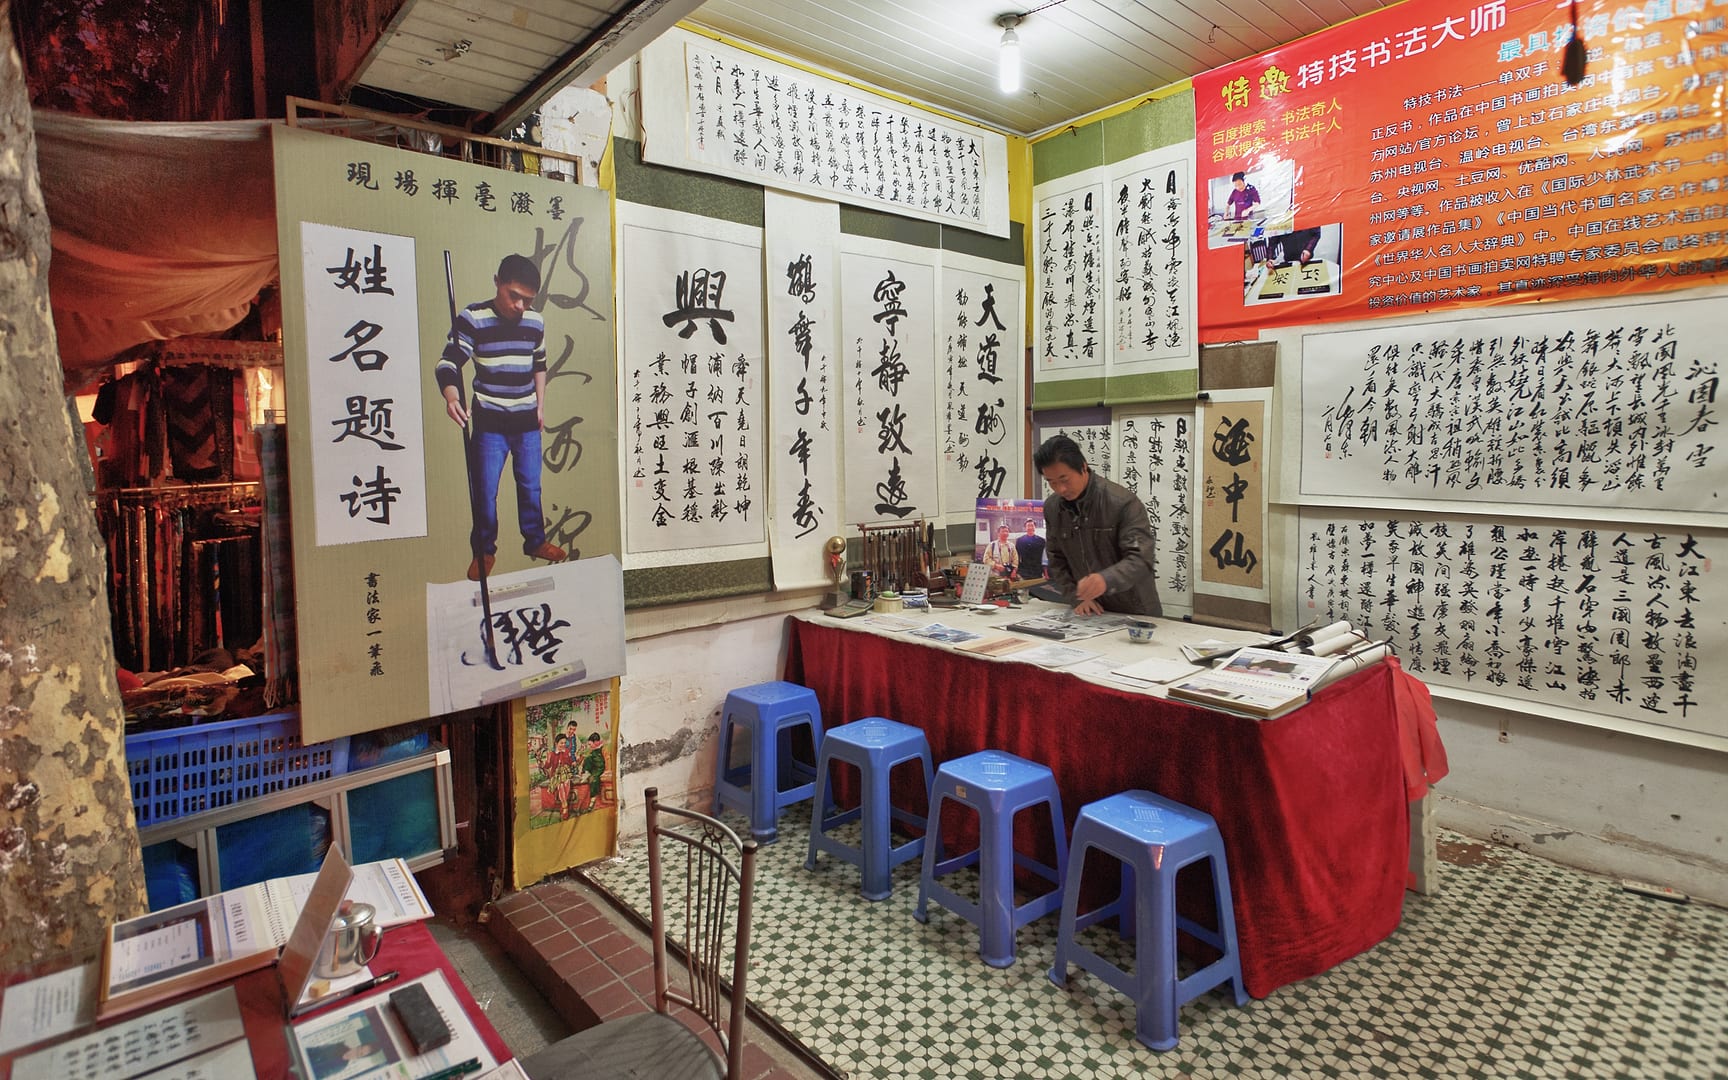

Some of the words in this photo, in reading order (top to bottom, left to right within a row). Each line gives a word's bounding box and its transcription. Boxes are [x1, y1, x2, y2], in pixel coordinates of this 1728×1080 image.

[1221, 65, 1292, 112] 特邀
[1212, 96, 1343, 147] 百度搜索：书法奇人
[345, 161, 566, 222] 現場揮毫潑墨
[1369, 151, 1728, 225] 州网等等。作品被收入在《国际少林武术节—中
[326, 243, 406, 526] 姓名题诗
